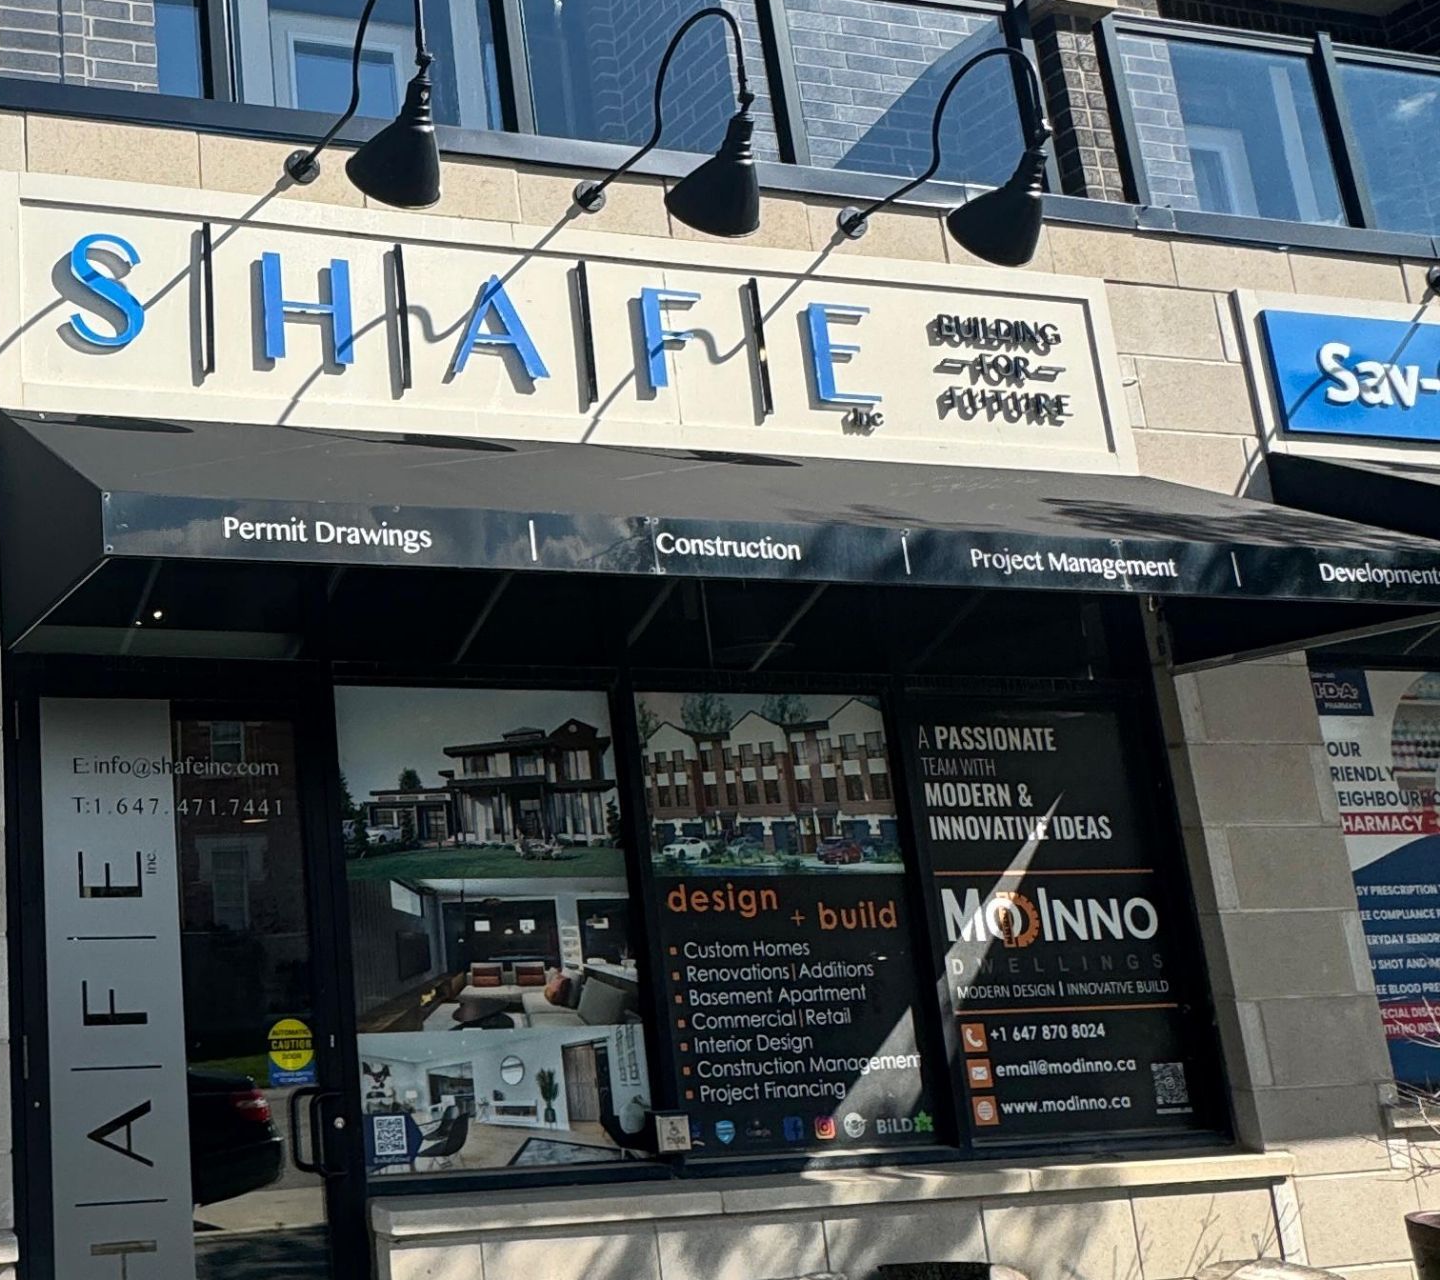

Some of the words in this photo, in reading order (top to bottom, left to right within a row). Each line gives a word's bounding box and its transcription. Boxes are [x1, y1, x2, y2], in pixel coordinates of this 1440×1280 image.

[936, 313, 1062, 347] BUILDING
[978, 353, 1033, 380] FOR
[948, 385, 1074, 418] FUTURE
[222, 516, 308, 543] Permit
[315, 520, 433, 554] Drawings
[655, 532, 802, 561] Construction
[970, 548, 1045, 575] Project
[1047, 552, 1179, 580] Management
[1319, 563, 1440, 588] Development
[918, 725, 930, 749] A
[934, 725, 1057, 752] PASSIONATE
[921, 756, 958, 776] TEAM
[959, 757, 997, 777] WITH
[924, 782, 1012, 807] MODERN
[1017, 783, 1034, 807] &
[929, 815, 1049, 841] INNOVATIVE
[1053, 815, 1113, 840] IDEAS
[1371, 884, 1437, 896] PRESCRIPTION
[667, 883, 779, 918] design
[817, 901, 898, 930] build
[1373, 909, 1435, 921] COMPLIANCE
[683, 941, 749, 960] Custom
[752, 940, 810, 957] Homes
[689, 987, 773, 1007] Basement
[777, 983, 867, 1006] Apartment
[957, 986, 1011, 1000] MODERN
[1013, 983, 1056, 998] DESIGN
[1067, 980, 1135, 996] INNOVATIVE
[1136, 979, 1170, 994] BUILD
[1388, 982, 1421, 994] BLOOD
[991, 1026, 1007, 1041] +1
[1012, 1025, 1038, 1041] 647
[1041, 1024, 1069, 1040] 870
[1071, 1022, 1106, 1039] 8024
[271, 1039, 312, 1050] CAUTION
[694, 1035, 752, 1055] Interior
[756, 1033, 814, 1054] Design
[696, 1055, 805, 1080] Construction
[995, 1057, 1137, 1077] email@modinno.ca
[699, 1081, 760, 1106] Project
[764, 1079, 847, 1101] Financing
[1001, 1095, 1132, 1115] www.modinno.ca
